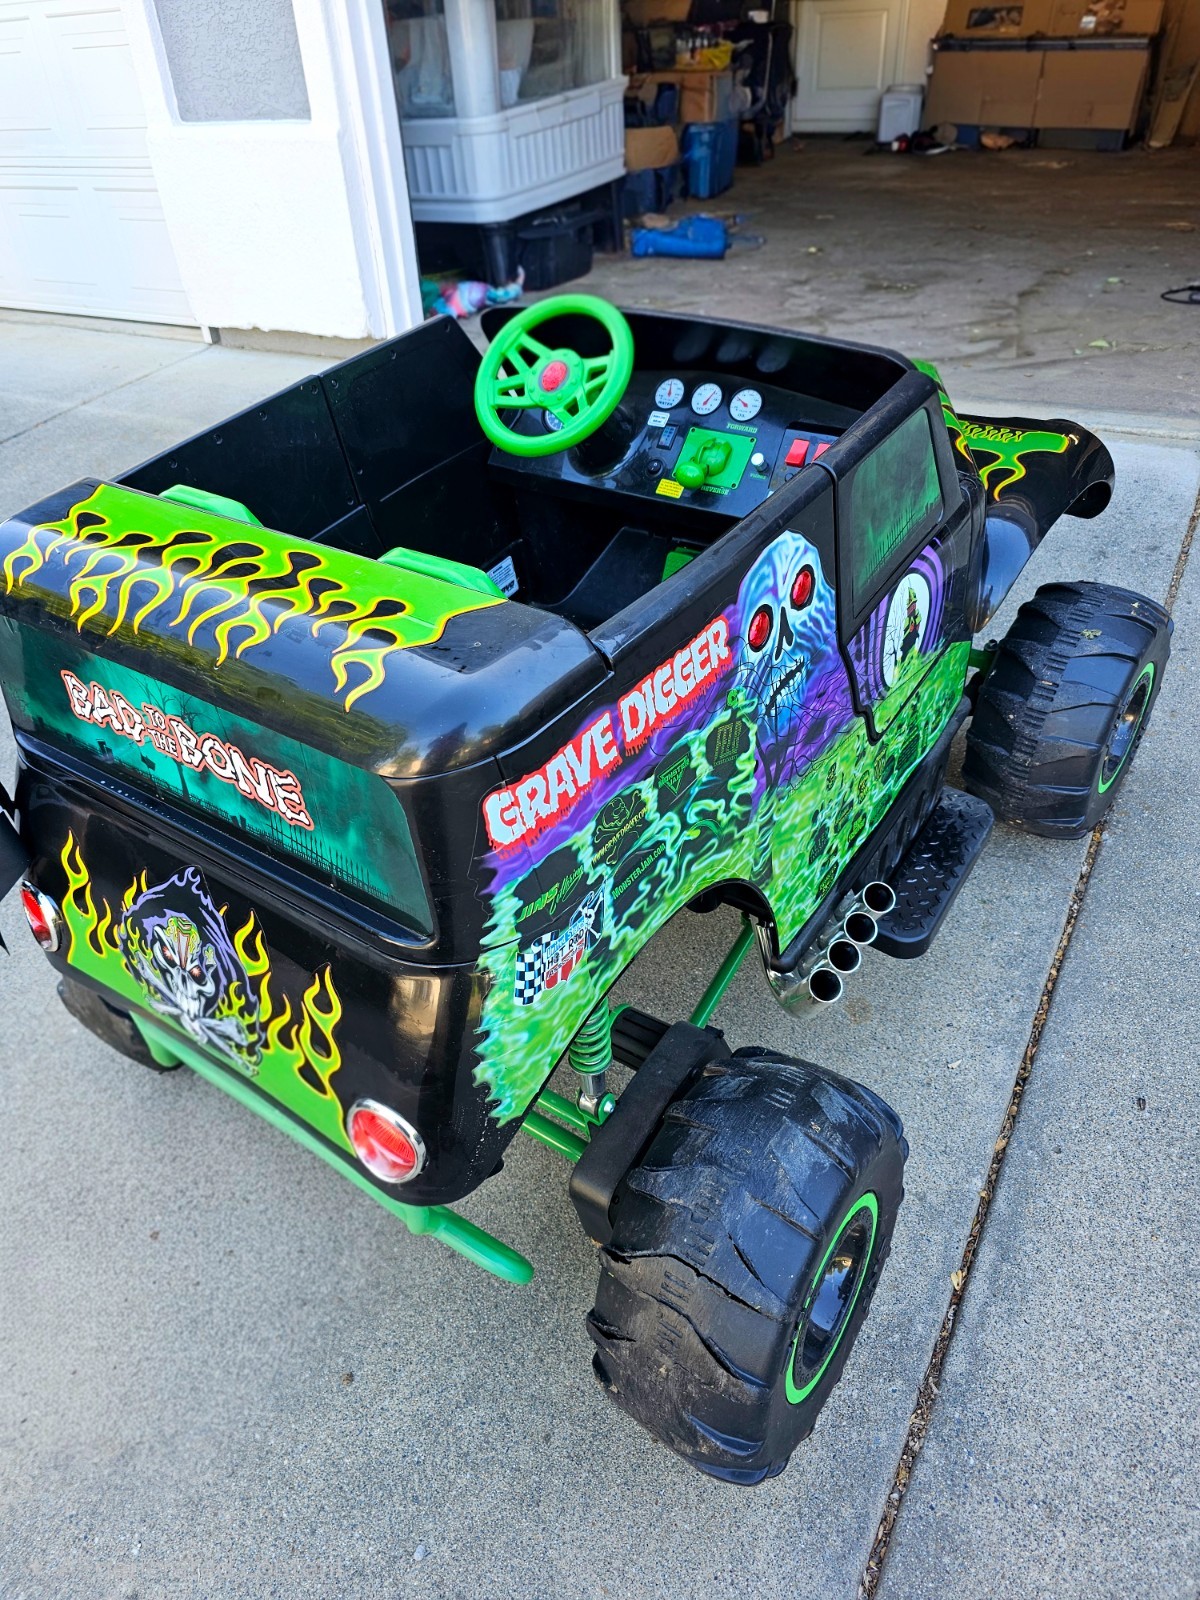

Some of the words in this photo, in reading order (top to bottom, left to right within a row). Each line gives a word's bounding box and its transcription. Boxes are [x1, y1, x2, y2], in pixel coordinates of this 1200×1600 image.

[726, 422, 758, 434] FORWARD
[62, 672, 146, 744] BAD
[143, 704, 167, 731] TO
[146, 726, 179, 758] THE
[483, 711, 620, 847] GRAVE
[619, 616, 731, 743] DIGGER
[169, 718, 312, 827] BONE
[547, 945, 566, 969] HOT
[568, 928, 586, 949] ROD
